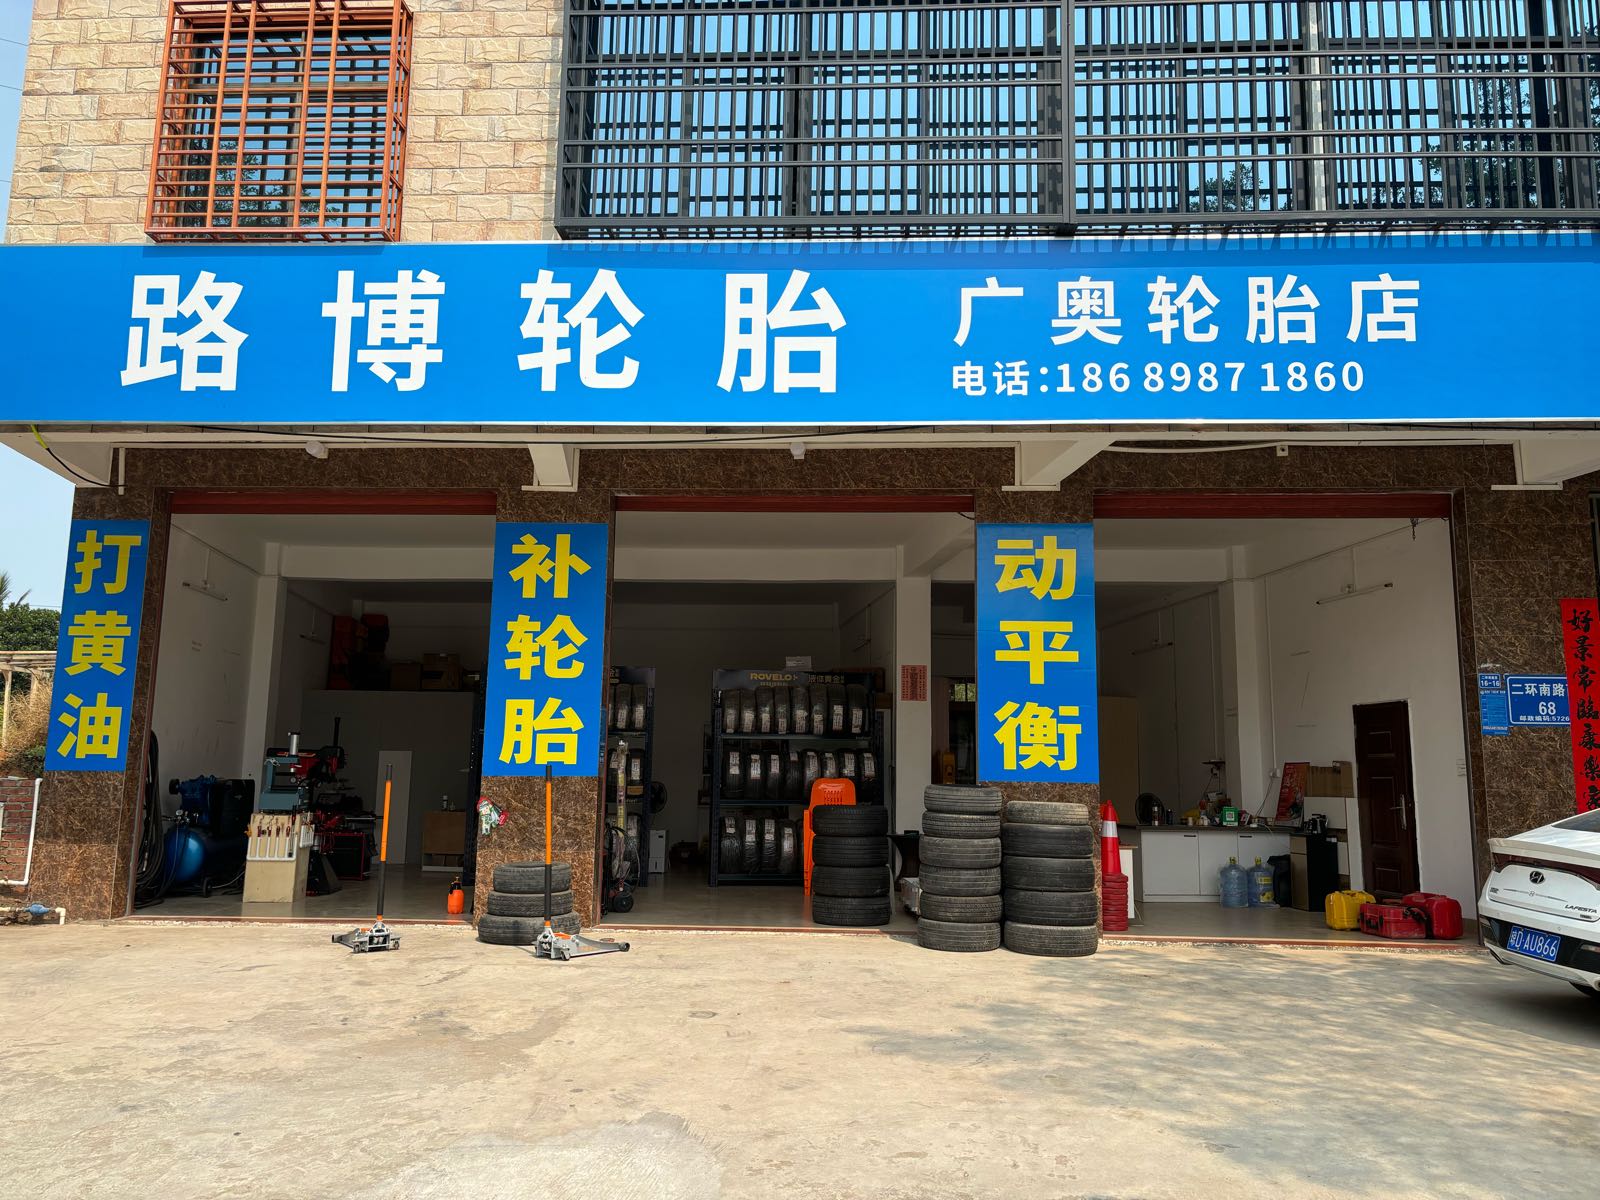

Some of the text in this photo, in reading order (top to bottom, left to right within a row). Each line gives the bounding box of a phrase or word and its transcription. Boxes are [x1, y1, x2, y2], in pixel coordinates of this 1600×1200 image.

[119, 268, 848, 394] 路博轮胎
[952, 272, 1421, 347] 广奥轮胎店
[56, 529, 142, 759] 打黄油
[498, 533, 592, 765] 补轮胎
[750, 672, 792, 681] ROVELO
[993, 535, 1082, 771] 动平衡
[1511, 682, 1567, 697] 二环南路
[1538, 701, 1557, 716] 68
[1564, 903, 1598, 914] LAFESTA
